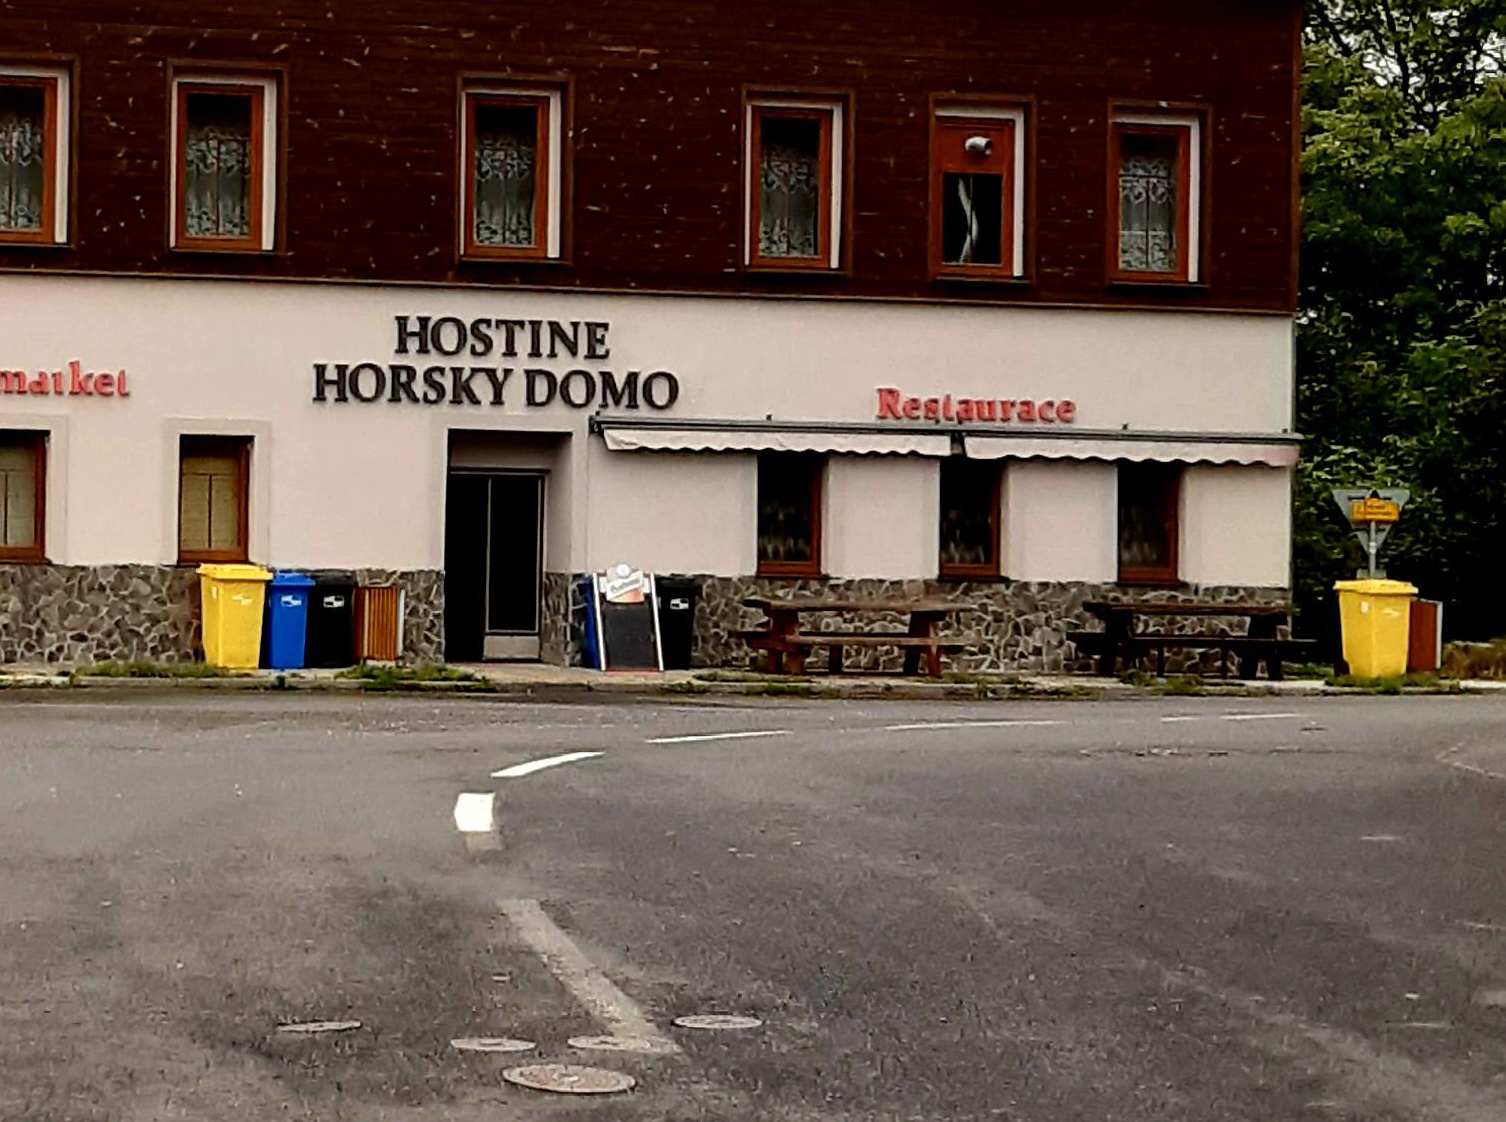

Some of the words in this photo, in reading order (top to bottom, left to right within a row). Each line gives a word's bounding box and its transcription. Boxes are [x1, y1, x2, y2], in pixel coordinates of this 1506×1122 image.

[394, 315, 611, 360] HOSTINE
[312, 362, 514, 407] HORSKY
[523, 368, 680, 411] DOMO
[876, 386, 1078, 424] Restaurace
